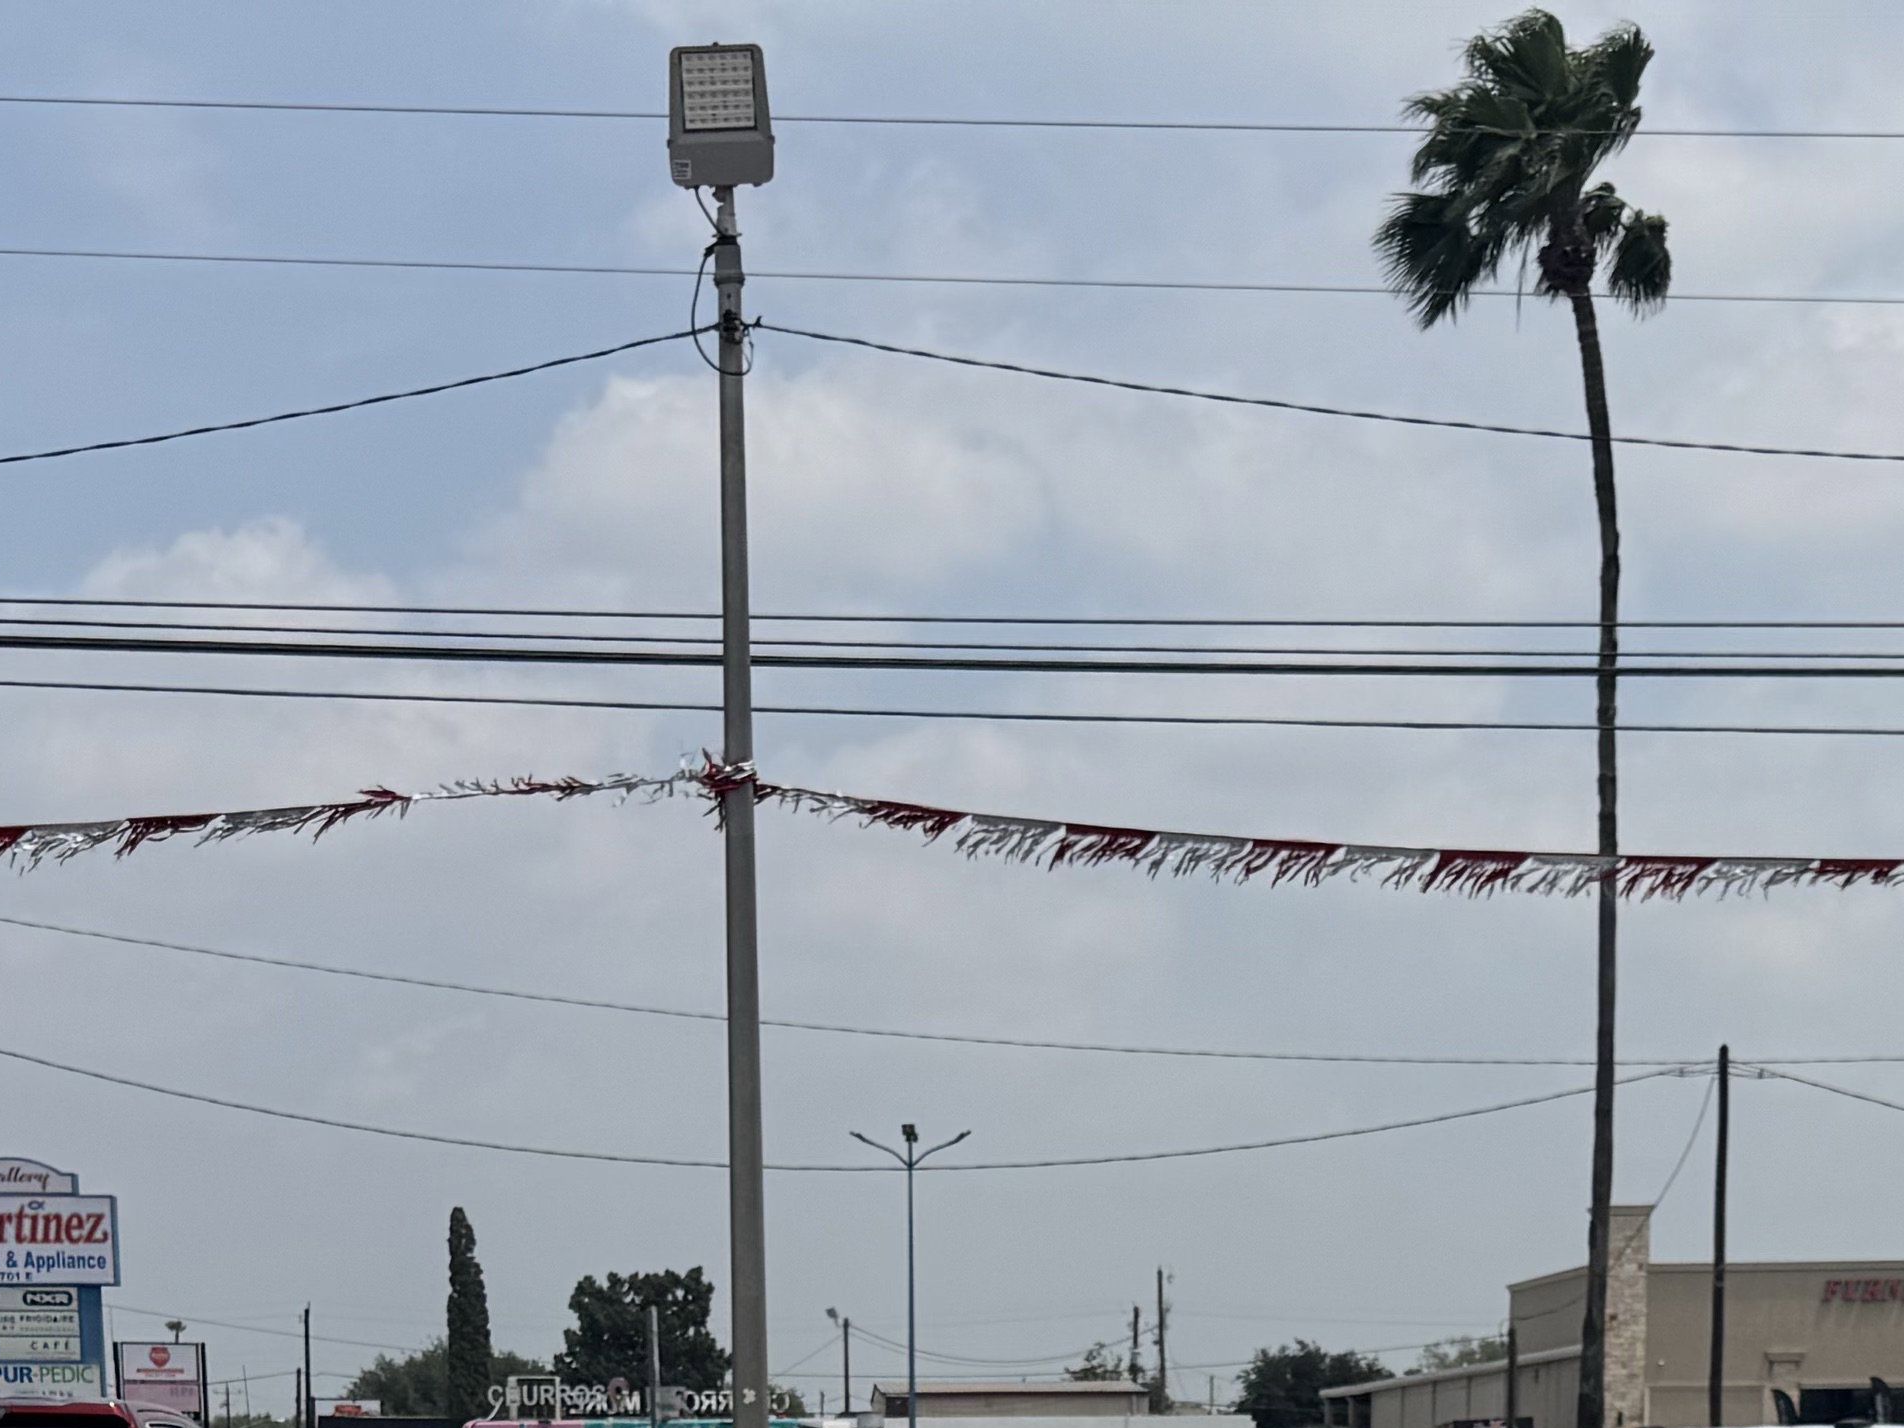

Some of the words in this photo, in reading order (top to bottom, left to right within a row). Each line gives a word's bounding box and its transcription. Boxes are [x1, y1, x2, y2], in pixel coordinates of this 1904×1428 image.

[5, 1251, 17, 1269] &
[24, 1251, 107, 1274] Appliance
[0, 1271, 21, 1281] 701
